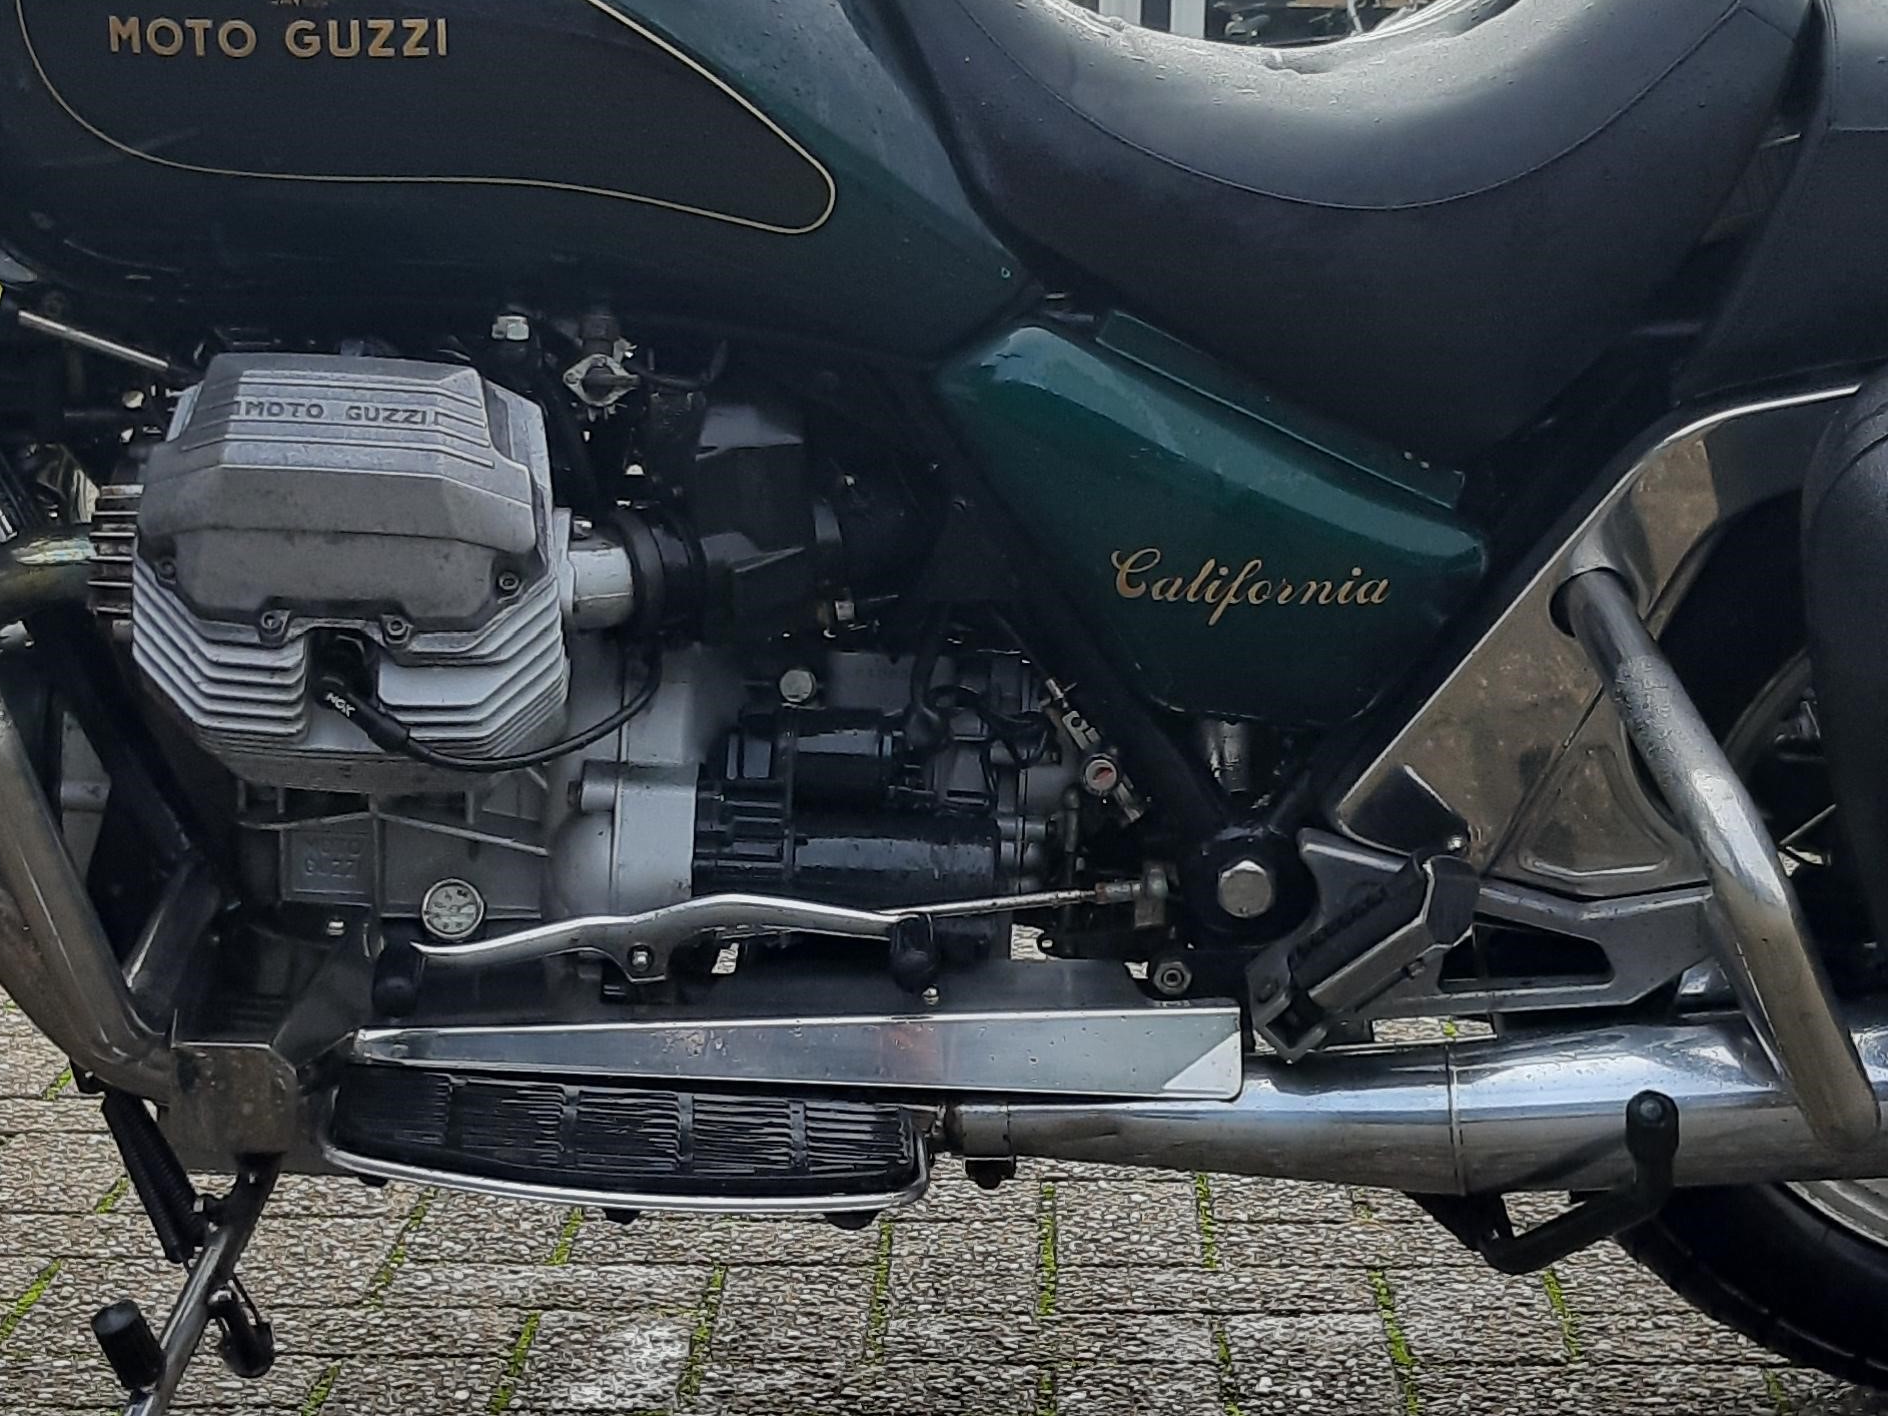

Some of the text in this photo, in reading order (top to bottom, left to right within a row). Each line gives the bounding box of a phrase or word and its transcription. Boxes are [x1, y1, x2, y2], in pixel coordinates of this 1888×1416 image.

[108, 15, 448, 59] MOTO GUZZI
[244, 400, 427, 426] MOTO GUZZI
[1110, 547, 1393, 626] California
